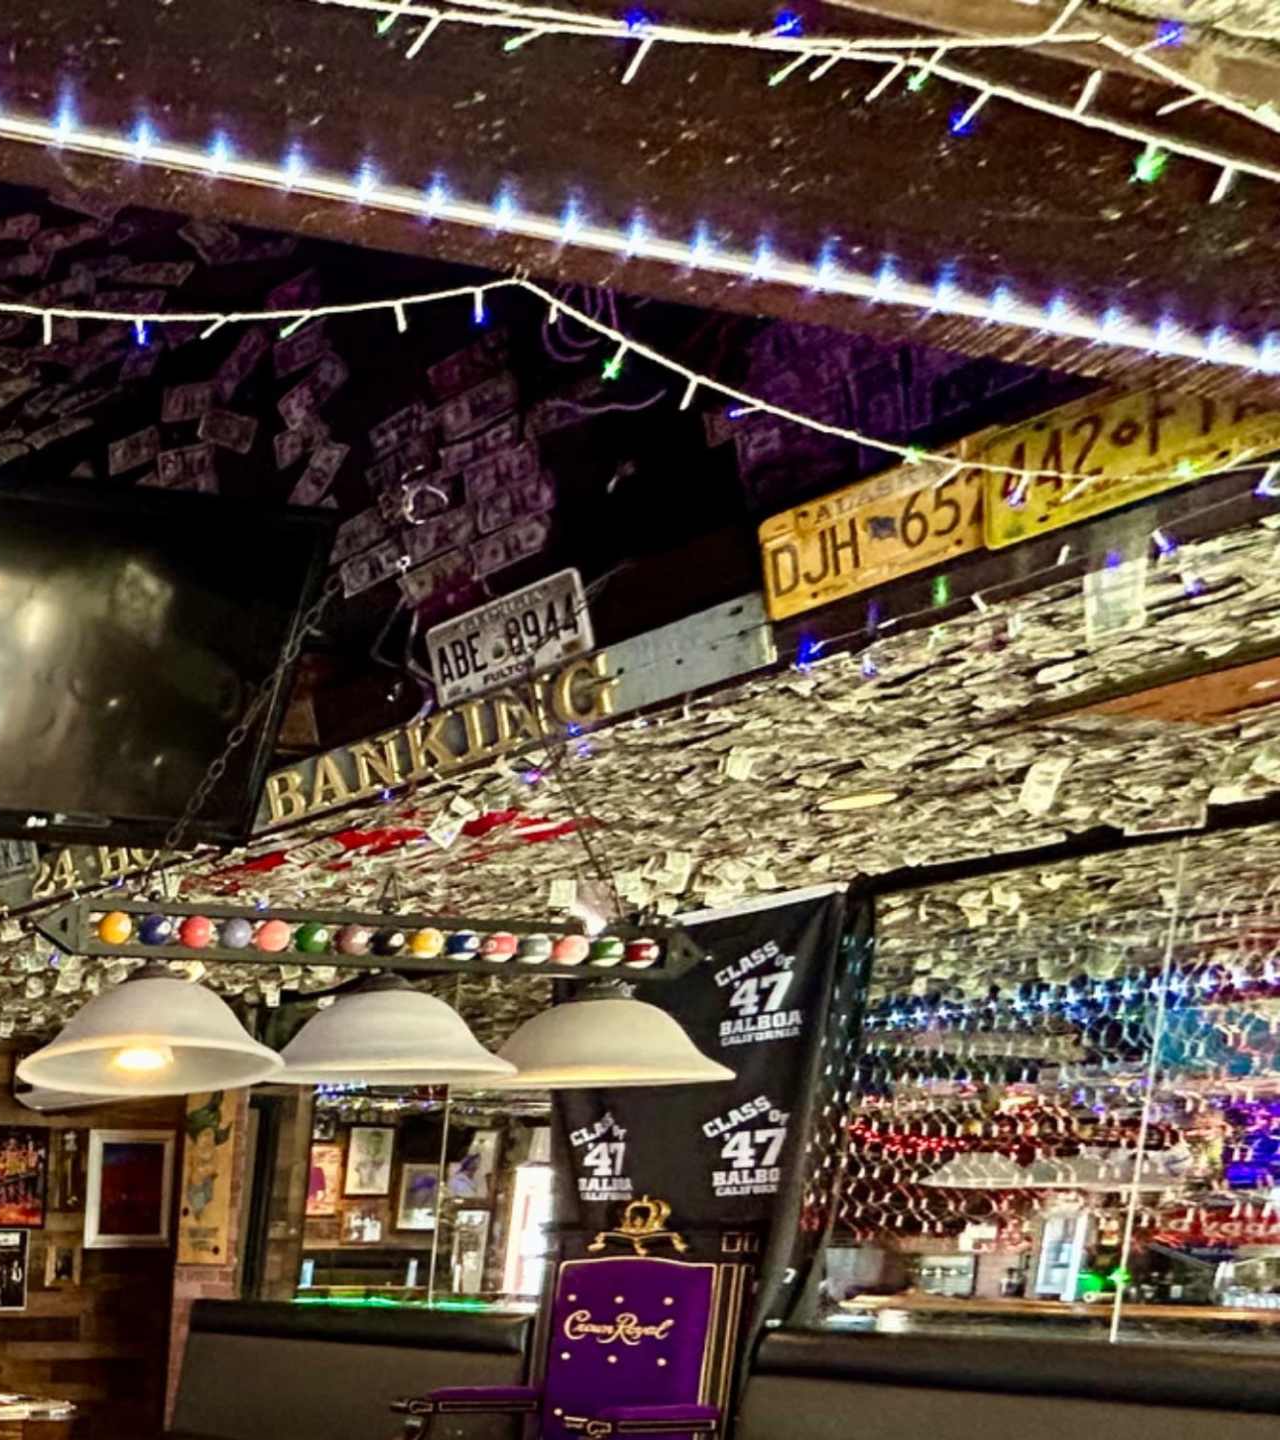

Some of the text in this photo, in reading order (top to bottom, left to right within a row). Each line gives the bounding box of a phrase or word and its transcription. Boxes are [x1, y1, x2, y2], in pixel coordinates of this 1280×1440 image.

[771, 517, 861, 598] DJH
[438, 592, 579, 686] ABE 8944
[266, 652, 621, 824] BANKING
[32, 849, 83, 898] 24
[714, 940, 779, 988] CLASS
[719, 1009, 802, 1037] BALBOA
[702, 1095, 771, 1138] CLASS
[564, 1309, 675, 1345] Crown Royal
